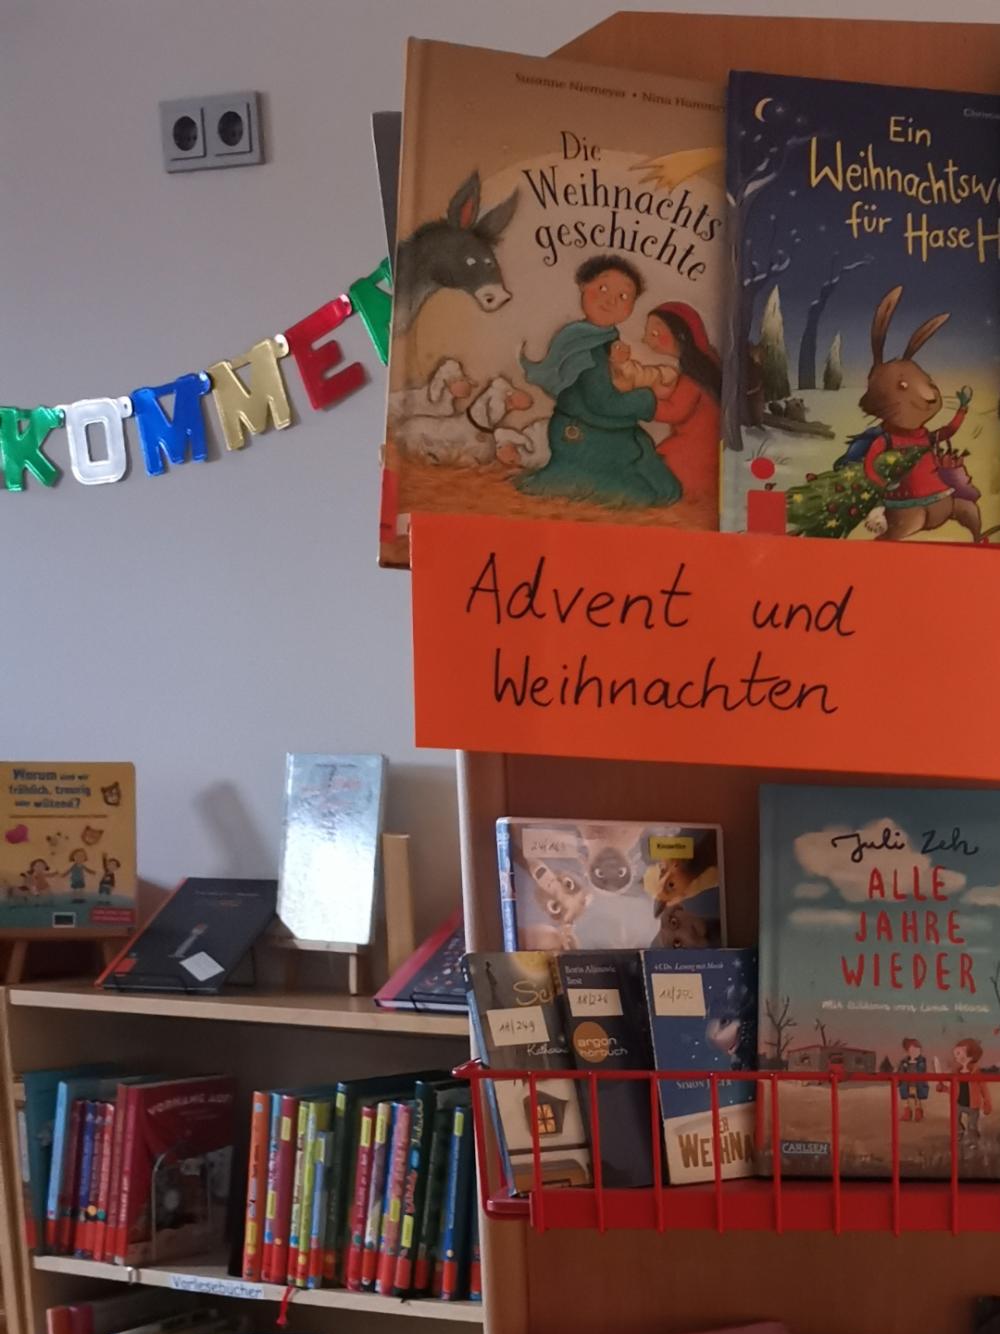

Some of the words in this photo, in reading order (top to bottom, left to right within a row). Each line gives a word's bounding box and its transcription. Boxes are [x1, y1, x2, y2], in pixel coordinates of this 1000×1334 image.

[560, 130, 602, 162] Die
[890, 116, 931, 147] Ein
[522, 165, 723, 242] Weihnachts
[535, 210, 707, 282] geschichte
[844, 201, 893, 239] für
[903, 212, 975, 262] Hase
[466, 552, 694, 631] Advent
[751, 586, 857, 637] und
[492, 648, 840, 715] Weihnachten
[831, 828, 906, 863] Juli
[920, 828, 979, 856] Zeh
[867, 865, 950, 902] ALLE
[854, 909, 966, 945] JAHRE
[840, 951, 977, 994] WIEDER
[577, 1037, 617, 1048] argon
